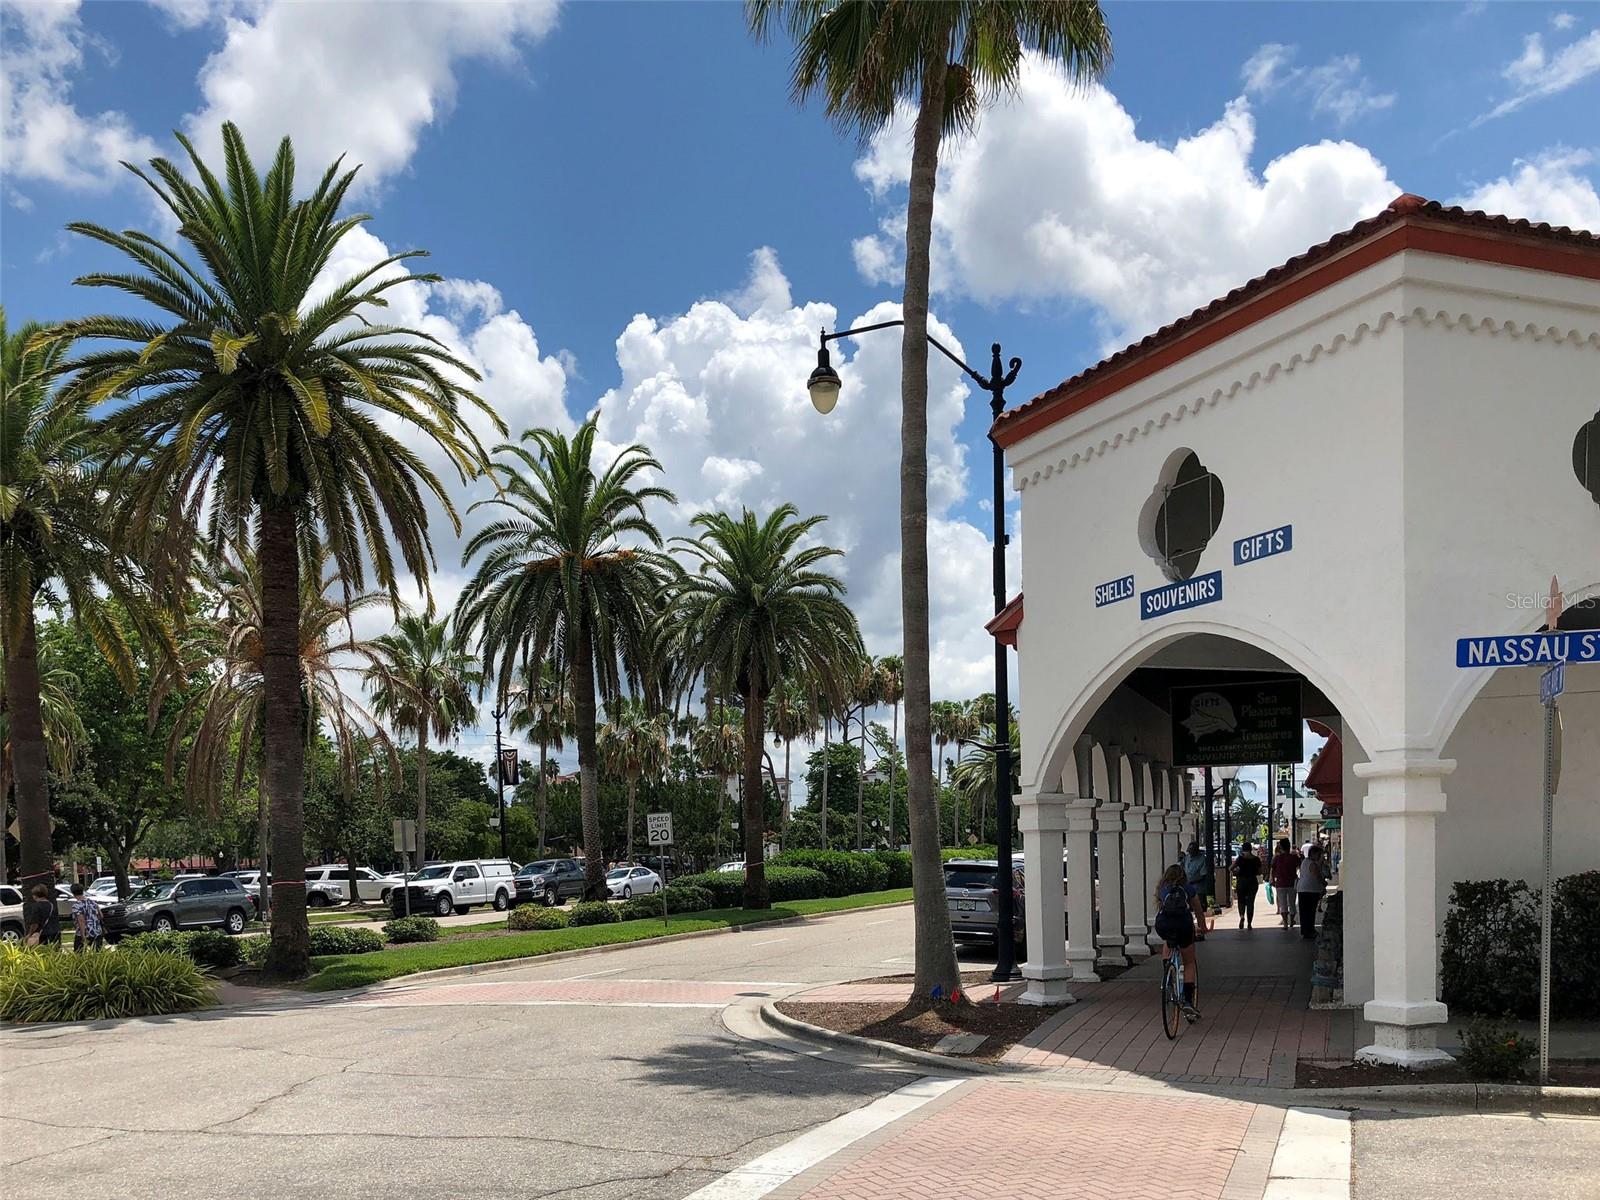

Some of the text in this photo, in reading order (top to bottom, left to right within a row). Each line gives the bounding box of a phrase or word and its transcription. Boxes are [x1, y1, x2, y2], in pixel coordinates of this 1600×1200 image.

[1240, 530, 1284, 561] GIFTS
[1095, 578, 1133, 605] SHELLS
[1146, 579, 1215, 613] SOUVENIRS
[1468, 636, 1569, 664] NASSAU
[650, 829, 669, 841] 20
